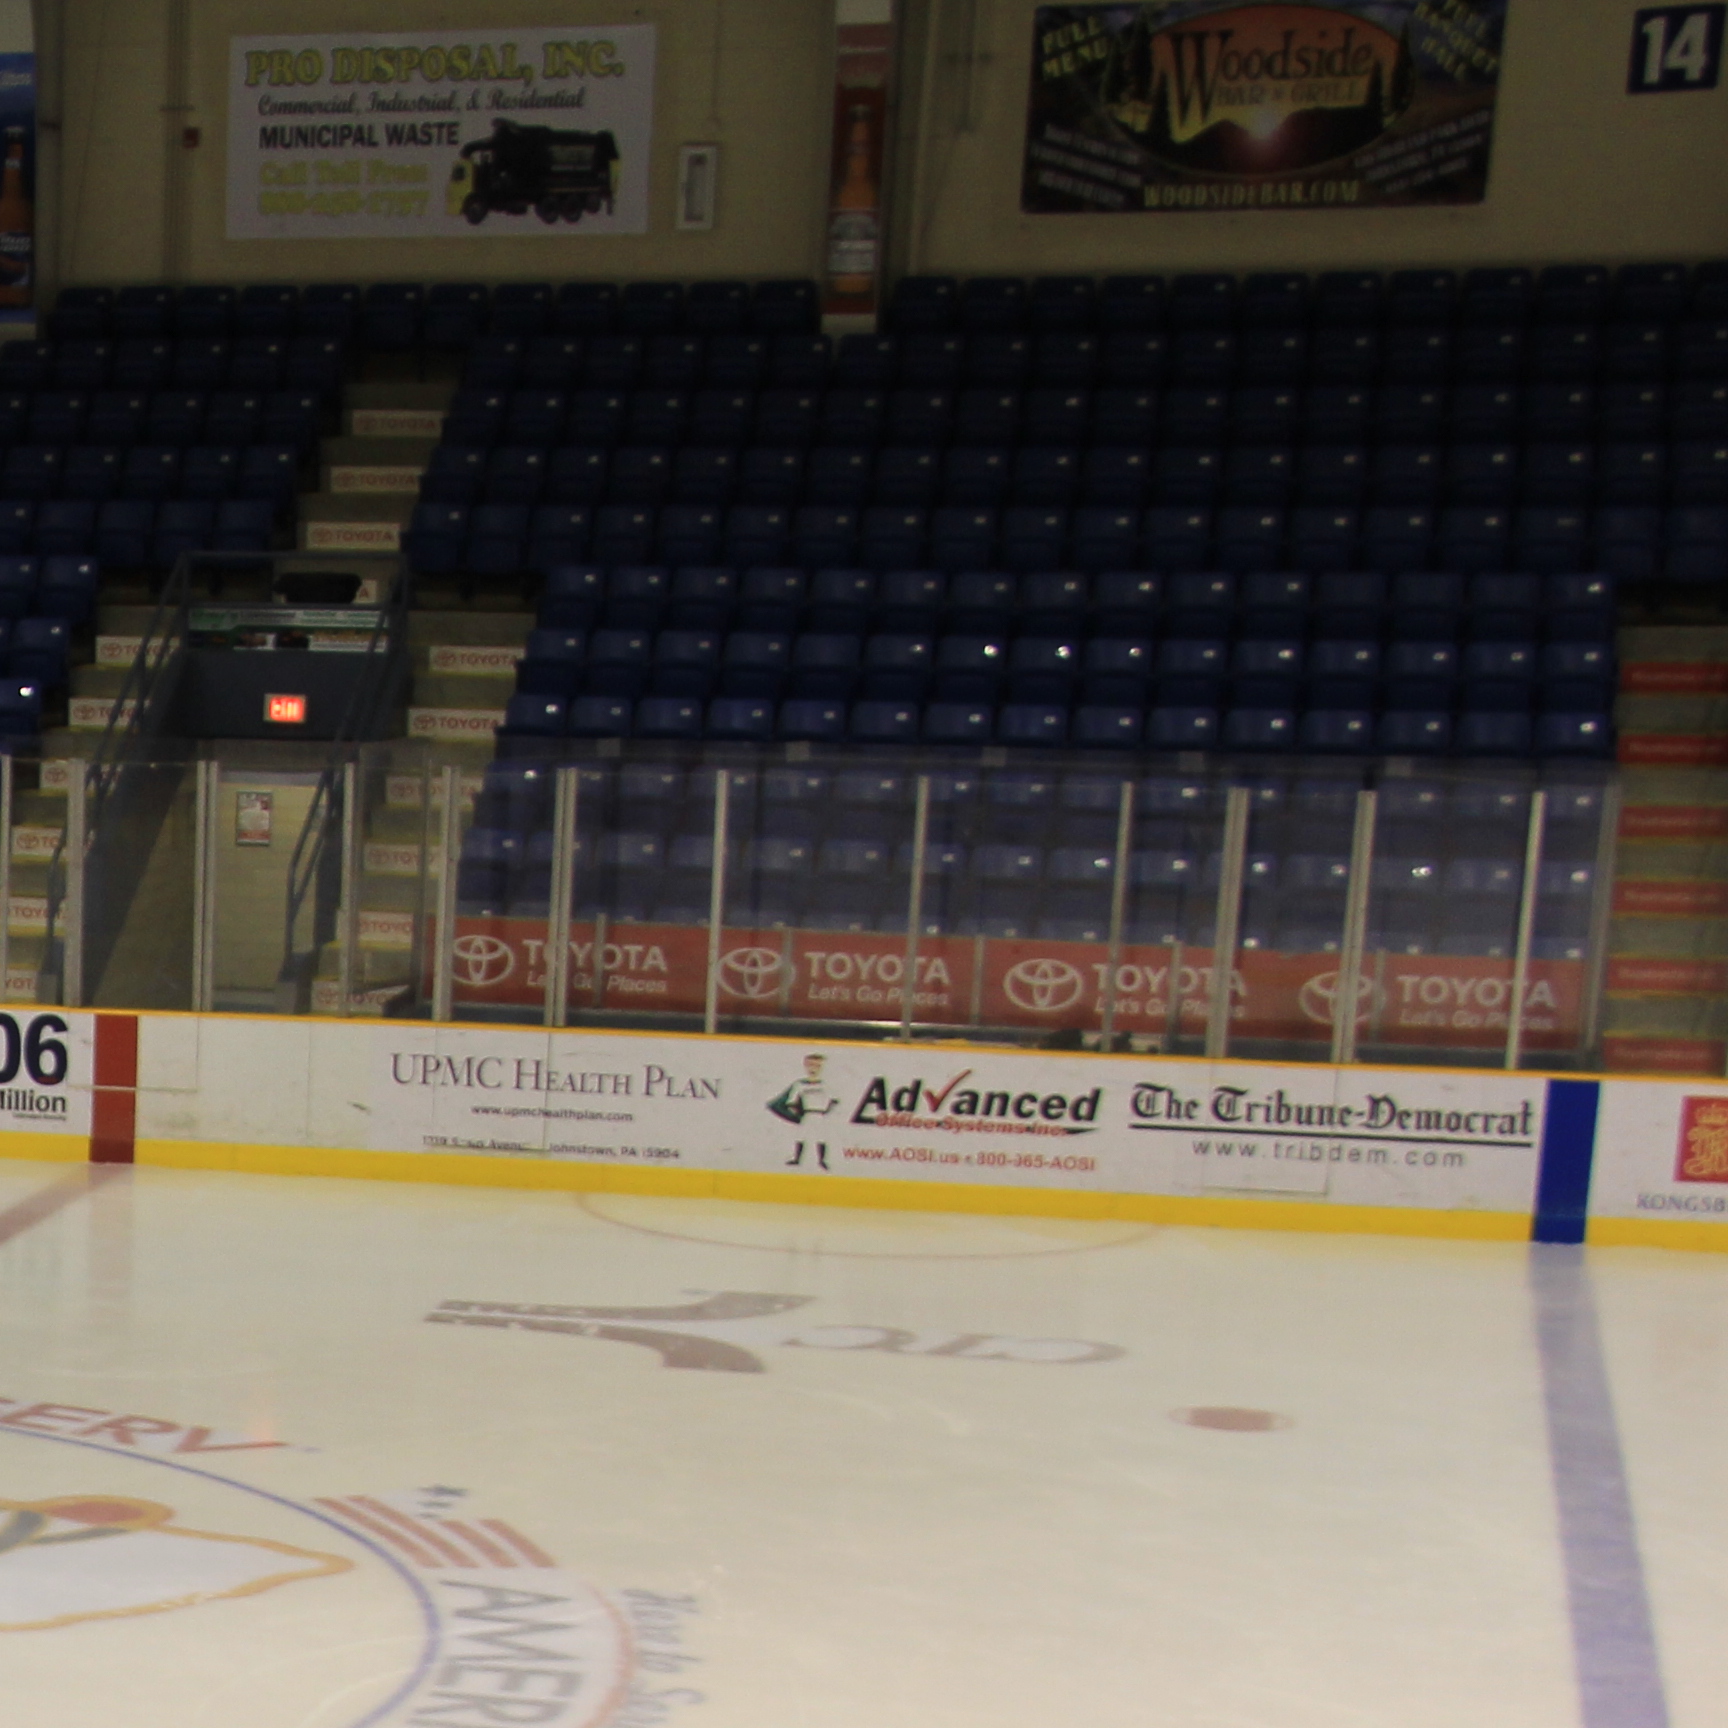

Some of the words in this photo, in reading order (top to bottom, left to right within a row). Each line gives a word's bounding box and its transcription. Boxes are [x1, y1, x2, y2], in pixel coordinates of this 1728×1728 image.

[1043, 16, 1101, 54] FULL
[1643, 14, 1710, 82] 14
[245, 48, 324, 87] PRO
[331, 41, 533, 87] DISPOSAL,
[542, 40, 625, 79] INC.
[1042, 36, 1106, 81] MENU
[1154, 27, 1374, 127] Woodside
[258, 91, 359, 116] Commercial,
[366, 90, 461, 115] Industrial,
[466, 92, 480, 111] &
[488, 87, 585, 111] Residential
[259, 123, 379, 149] MUNICIPAL
[385, 122, 459, 146] WASTE
[1143, 180, 1360, 207] WOODSIDEBAR.COM
[390, 1051, 504, 1090] UPMC
[471, 1105, 633, 1122] www.upmchealthplan.com
[943, 1115, 1025, 1135] Systems
[1129, 1081, 1197, 1123] The
[1211, 1086, 1534, 1138] Tribune-Democrat
[843, 1145, 960, 1165] www.AOSI.us
[1191, 1137, 1465, 1170] www.tribdem.com
